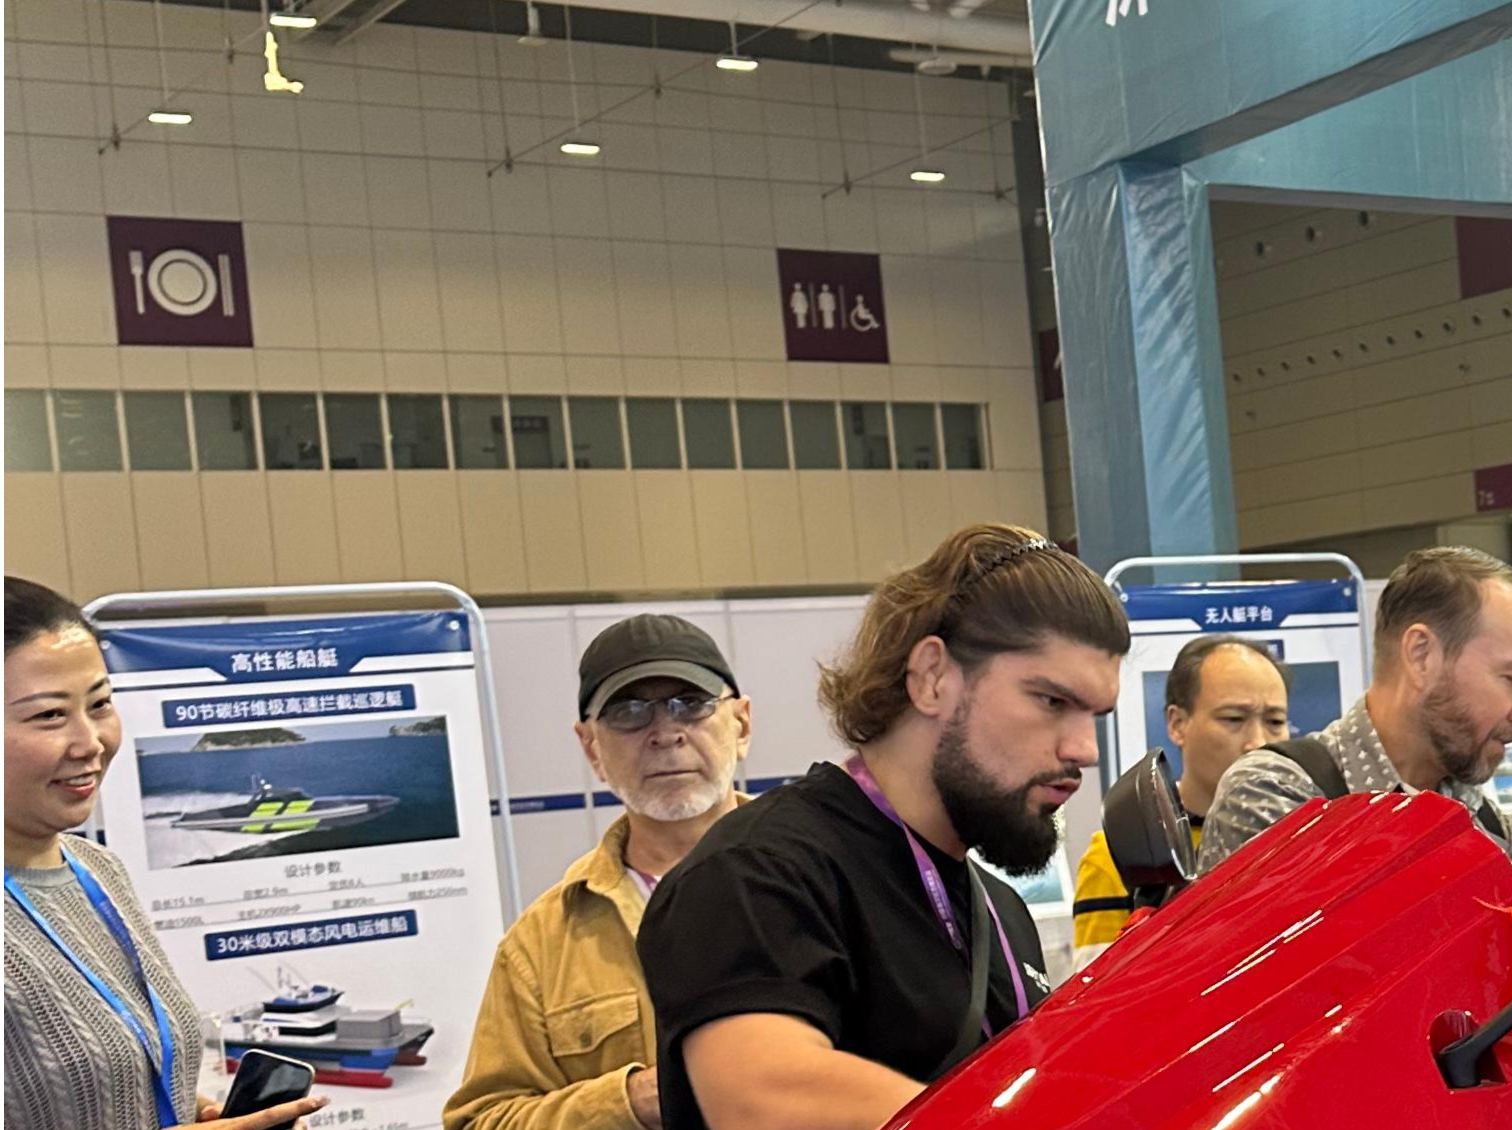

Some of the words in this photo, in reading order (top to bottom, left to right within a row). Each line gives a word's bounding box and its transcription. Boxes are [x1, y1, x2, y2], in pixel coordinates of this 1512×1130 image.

[1205, 606, 1274, 625] 无人艇平台
[231, 648, 339, 673] 高性能船艇
[284, 861, 343, 879] 设计参数
[217, 916, 409, 952] 30米级双模态风电运维船
[309, 1109, 365, 1128] 设计参数
